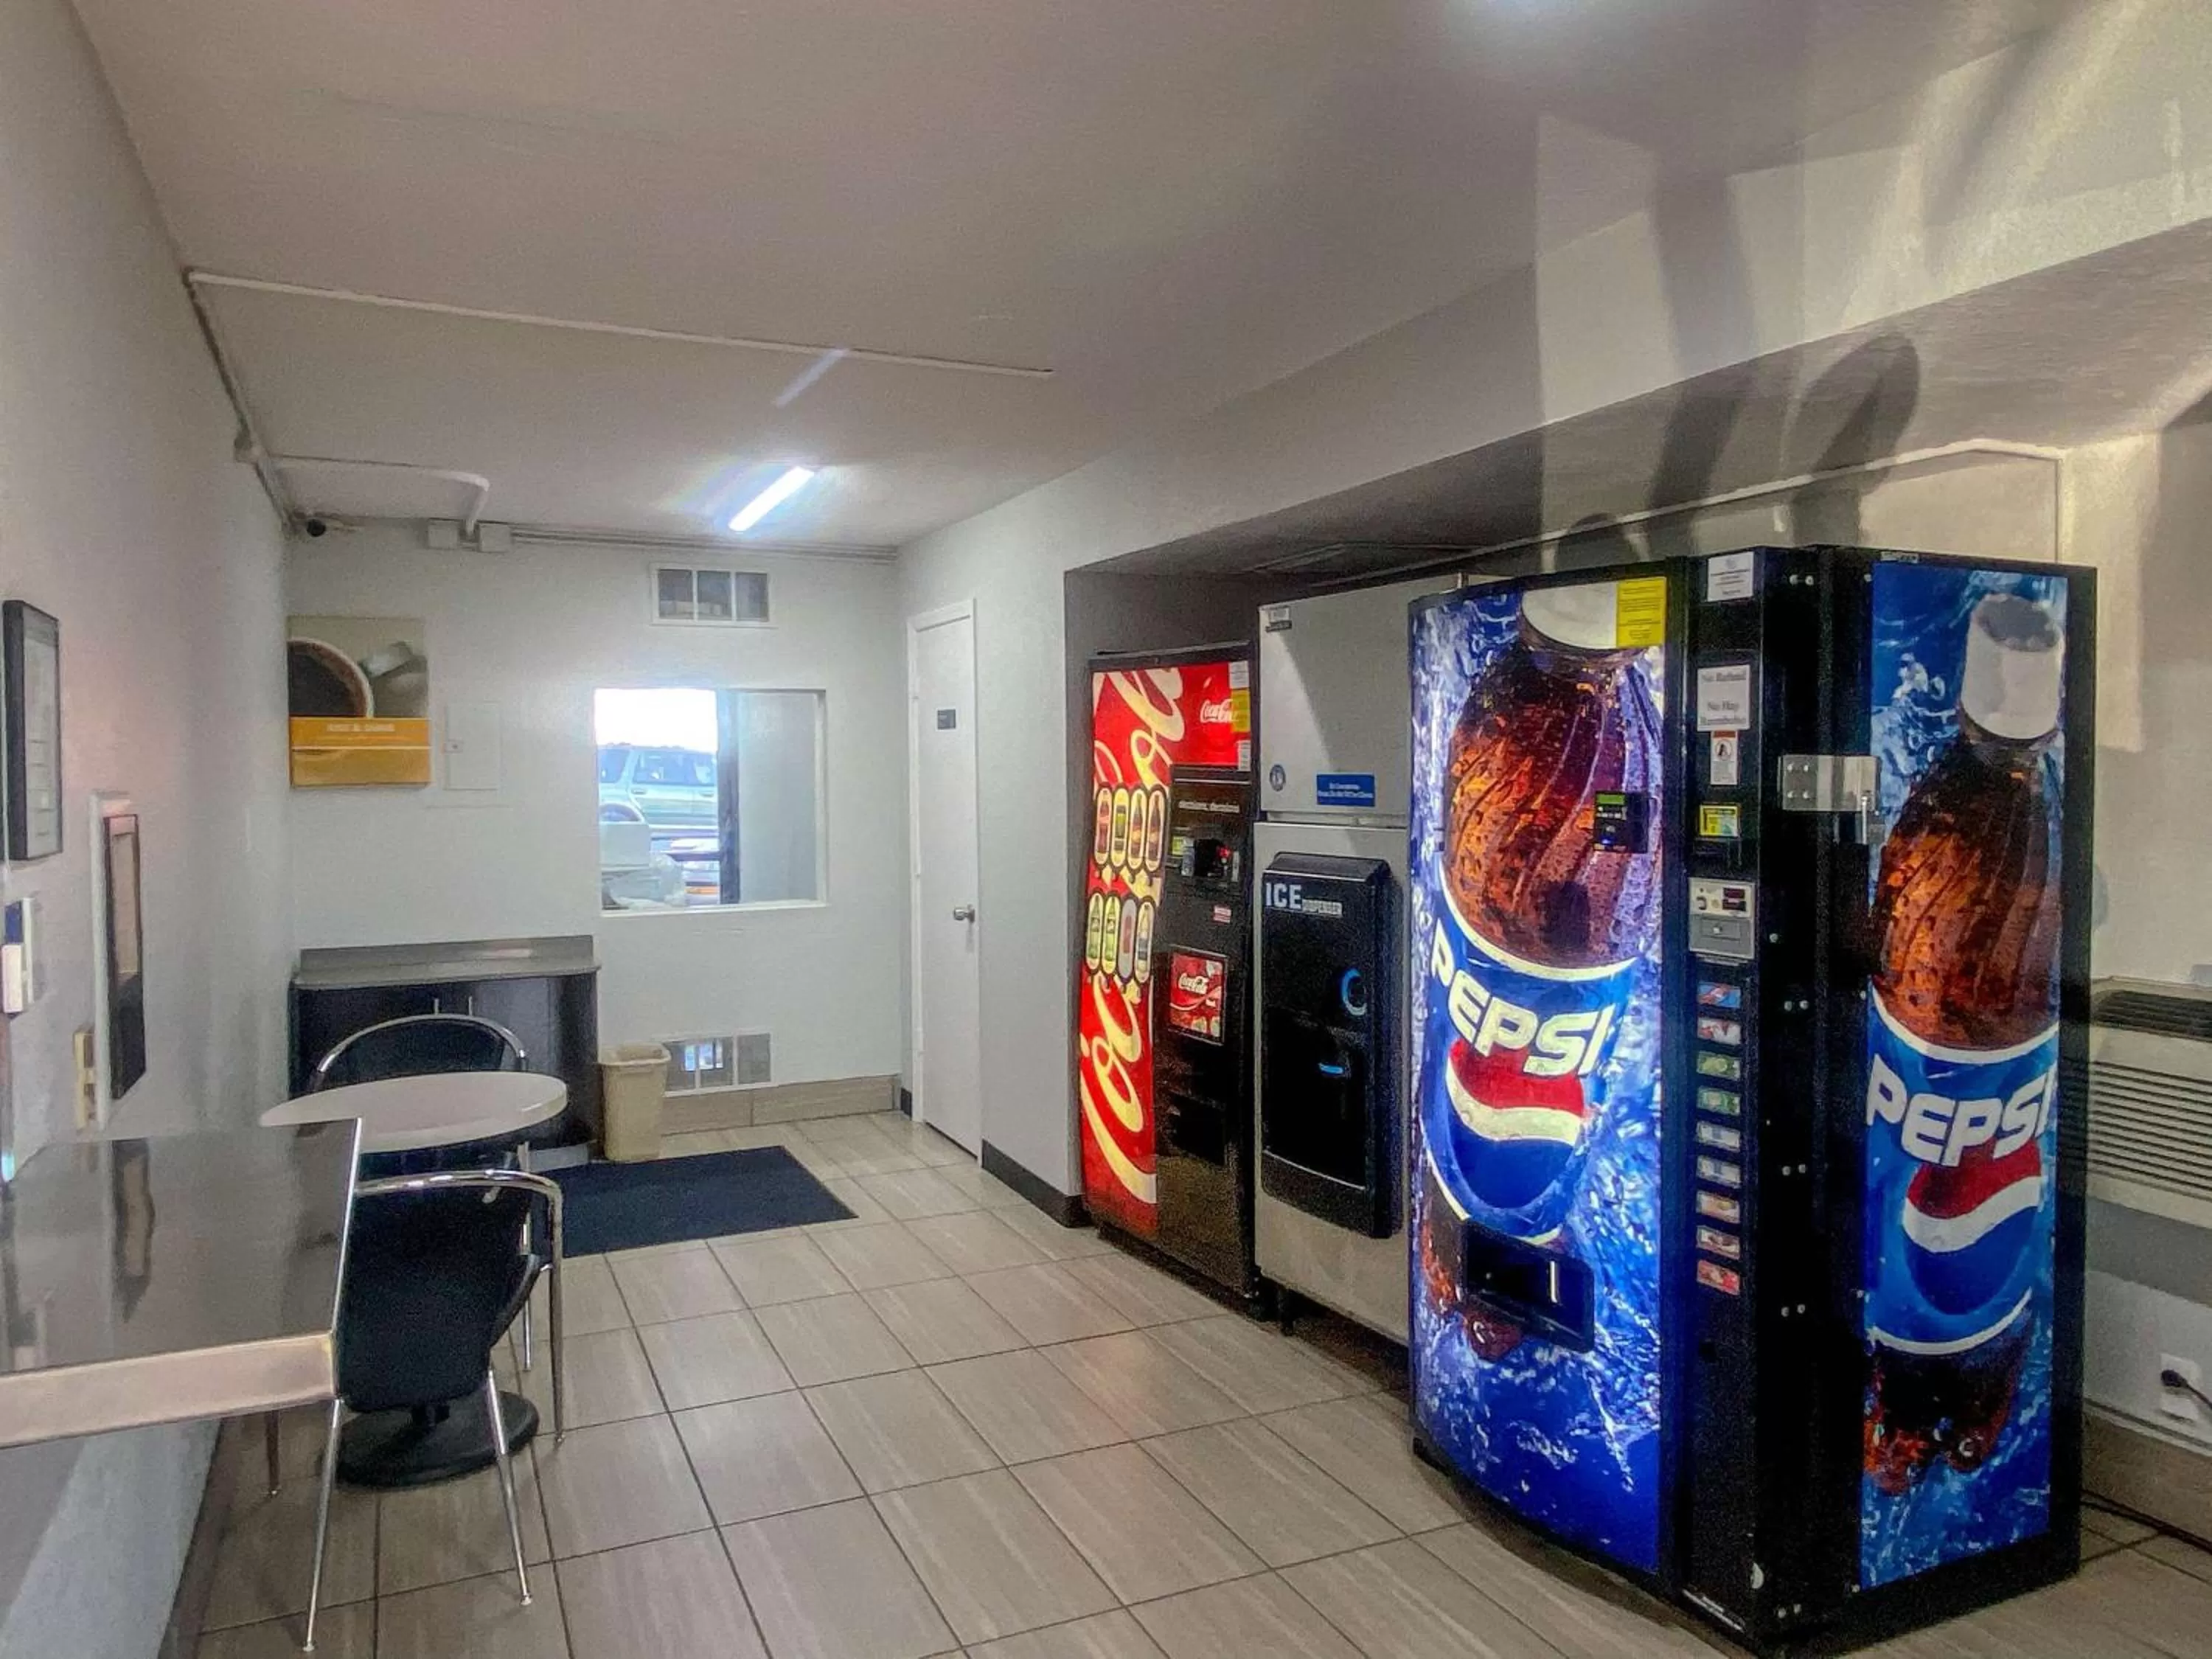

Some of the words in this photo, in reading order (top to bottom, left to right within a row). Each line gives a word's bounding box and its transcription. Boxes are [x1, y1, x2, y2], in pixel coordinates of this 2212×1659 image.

[1265, 882, 1302, 910] ICE
[1430, 918, 1616, 1077] PEPSI
[1865, 1053, 2059, 1167] PEPSI
